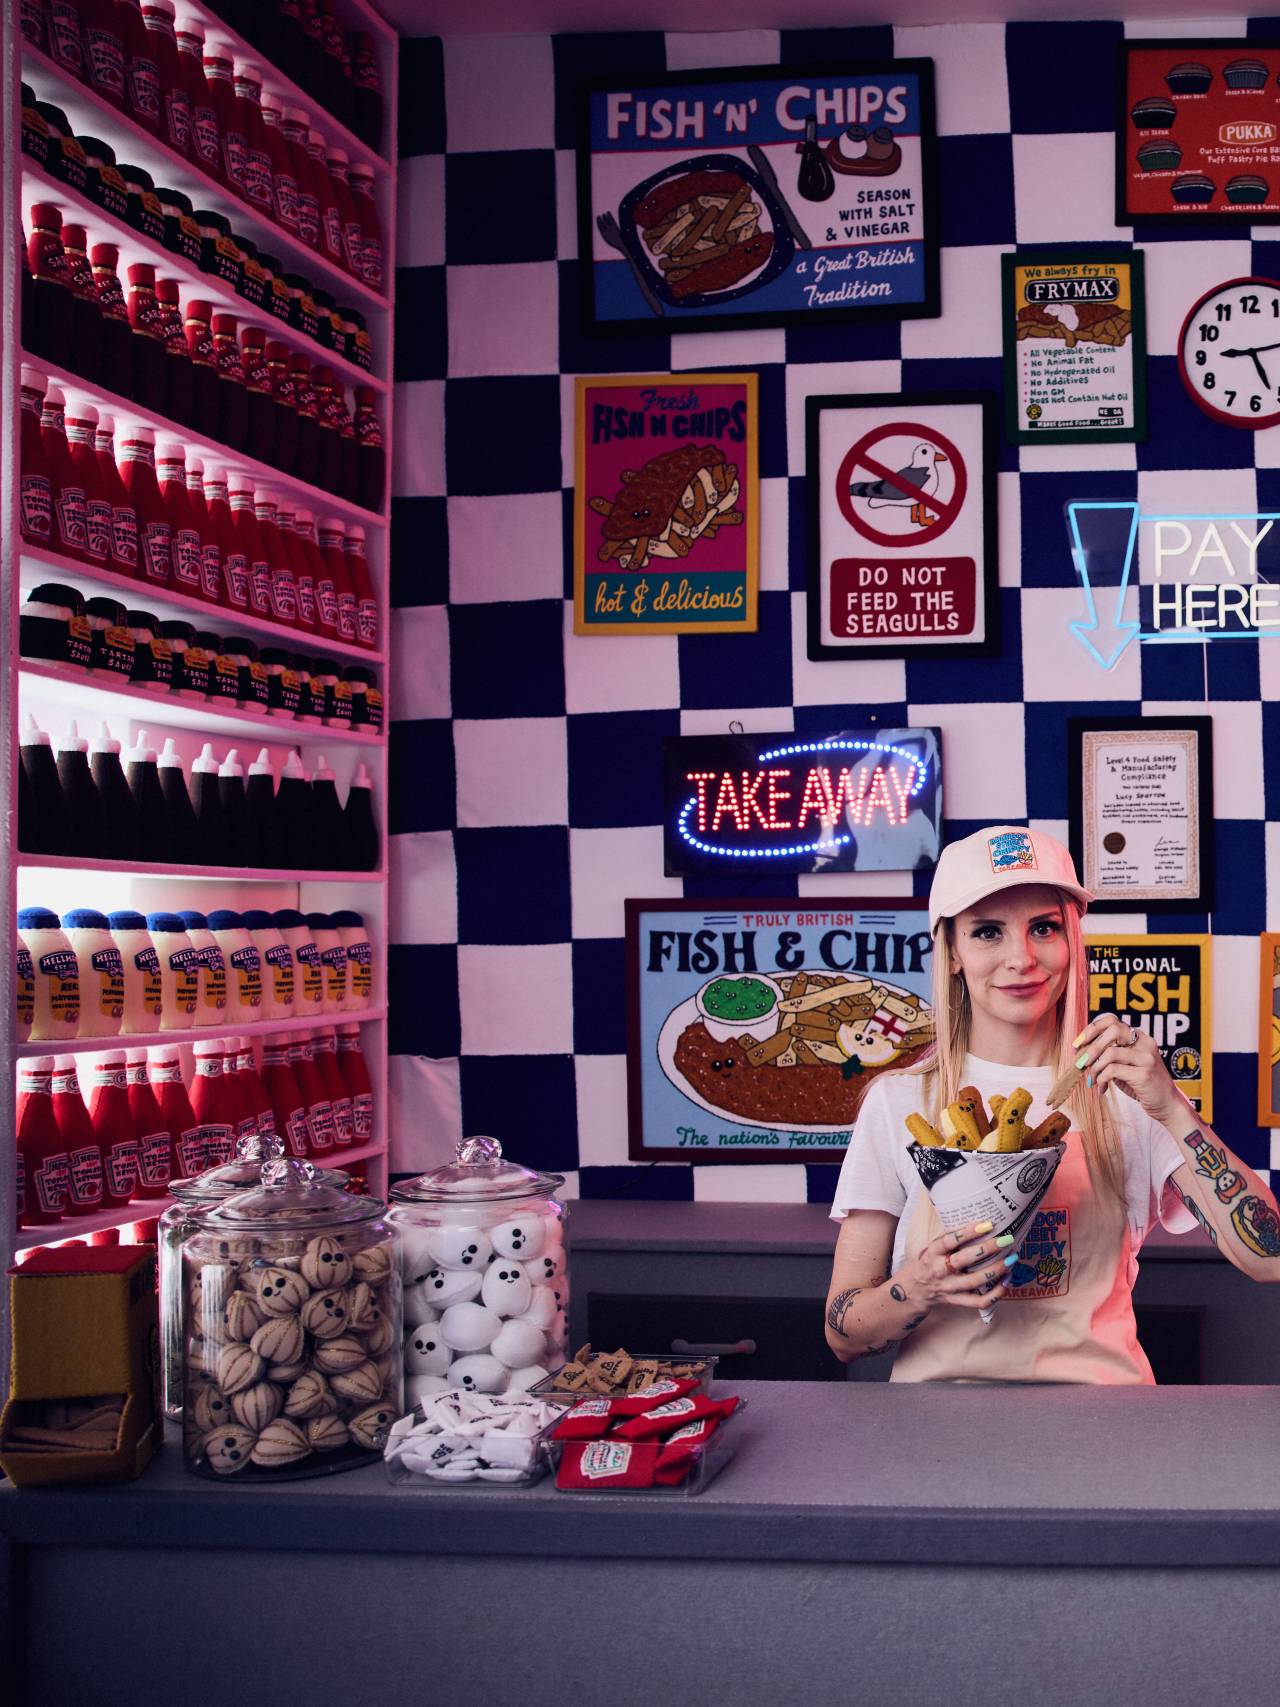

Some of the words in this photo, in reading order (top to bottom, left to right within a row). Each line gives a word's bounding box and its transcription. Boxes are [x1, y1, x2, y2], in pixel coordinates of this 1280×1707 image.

[607, 93, 705, 140] FISH
[775, 86, 907, 132] CHIPS
[1226, 125, 1272, 140] PUKKA
[857, 189, 911, 203] SEASON
[839, 207, 873, 222] WITH
[879, 203, 916, 219] SALT
[826, 228, 838, 241] &
[844, 222, 909, 238] VINEGAR
[812, 254, 852, 281] Great
[855, 248, 915, 269] British
[1025, 267, 1041, 278] We
[1044, 266, 1079, 278] always
[1082, 265, 1099, 278] fry
[1103, 266, 1116, 275] in
[804, 281, 892, 306] Tradition
[1034, 278, 1115, 298] FRYMAX
[1215, 304, 1232, 321] 11
[1240, 295, 1260, 314] 12
[1271, 299, 1280, 317] 1
[1199, 325, 1219, 342] 10
[1195, 351, 1206, 365] 9
[1203, 372, 1216, 389] 8
[639, 388, 698, 411] Fresh
[1224, 391, 1237, 406] 7
[1250, 395, 1262, 412] 6
[593, 403, 645, 444] FISH
[671, 401, 746, 443] CHIPS
[1154, 519, 1274, 577] PAY
[858, 566, 887, 587] DO
[902, 566, 947, 587] NOT
[596, 581, 623, 613] hot
[631, 580, 646, 618] &
[653, 577, 743, 611] delicious
[846, 591, 898, 611] FEED
[910, 591, 954, 611] THE
[845, 612, 959, 635] SEAGULLS
[686, 768, 792, 832] TAKE
[797, 766, 917, 828] AWAY
[743, 914, 790, 927] TRULY
[797, 913, 854, 926] BRITISH
[646, 930, 758, 973] FISH
[775, 932, 805, 970] &
[819, 929, 933, 973] CHIP
[1094, 947, 1120, 958] THE
[1089, 957, 1181, 973] NATIONAL
[1089, 972, 1191, 1013] FISH
[1093, 1013, 1191, 1047] HIP
[676, 1127, 708, 1146] The
[719, 1132, 779, 1145] nation's
[1003, 1286, 1060, 1297] AKEAWAY
